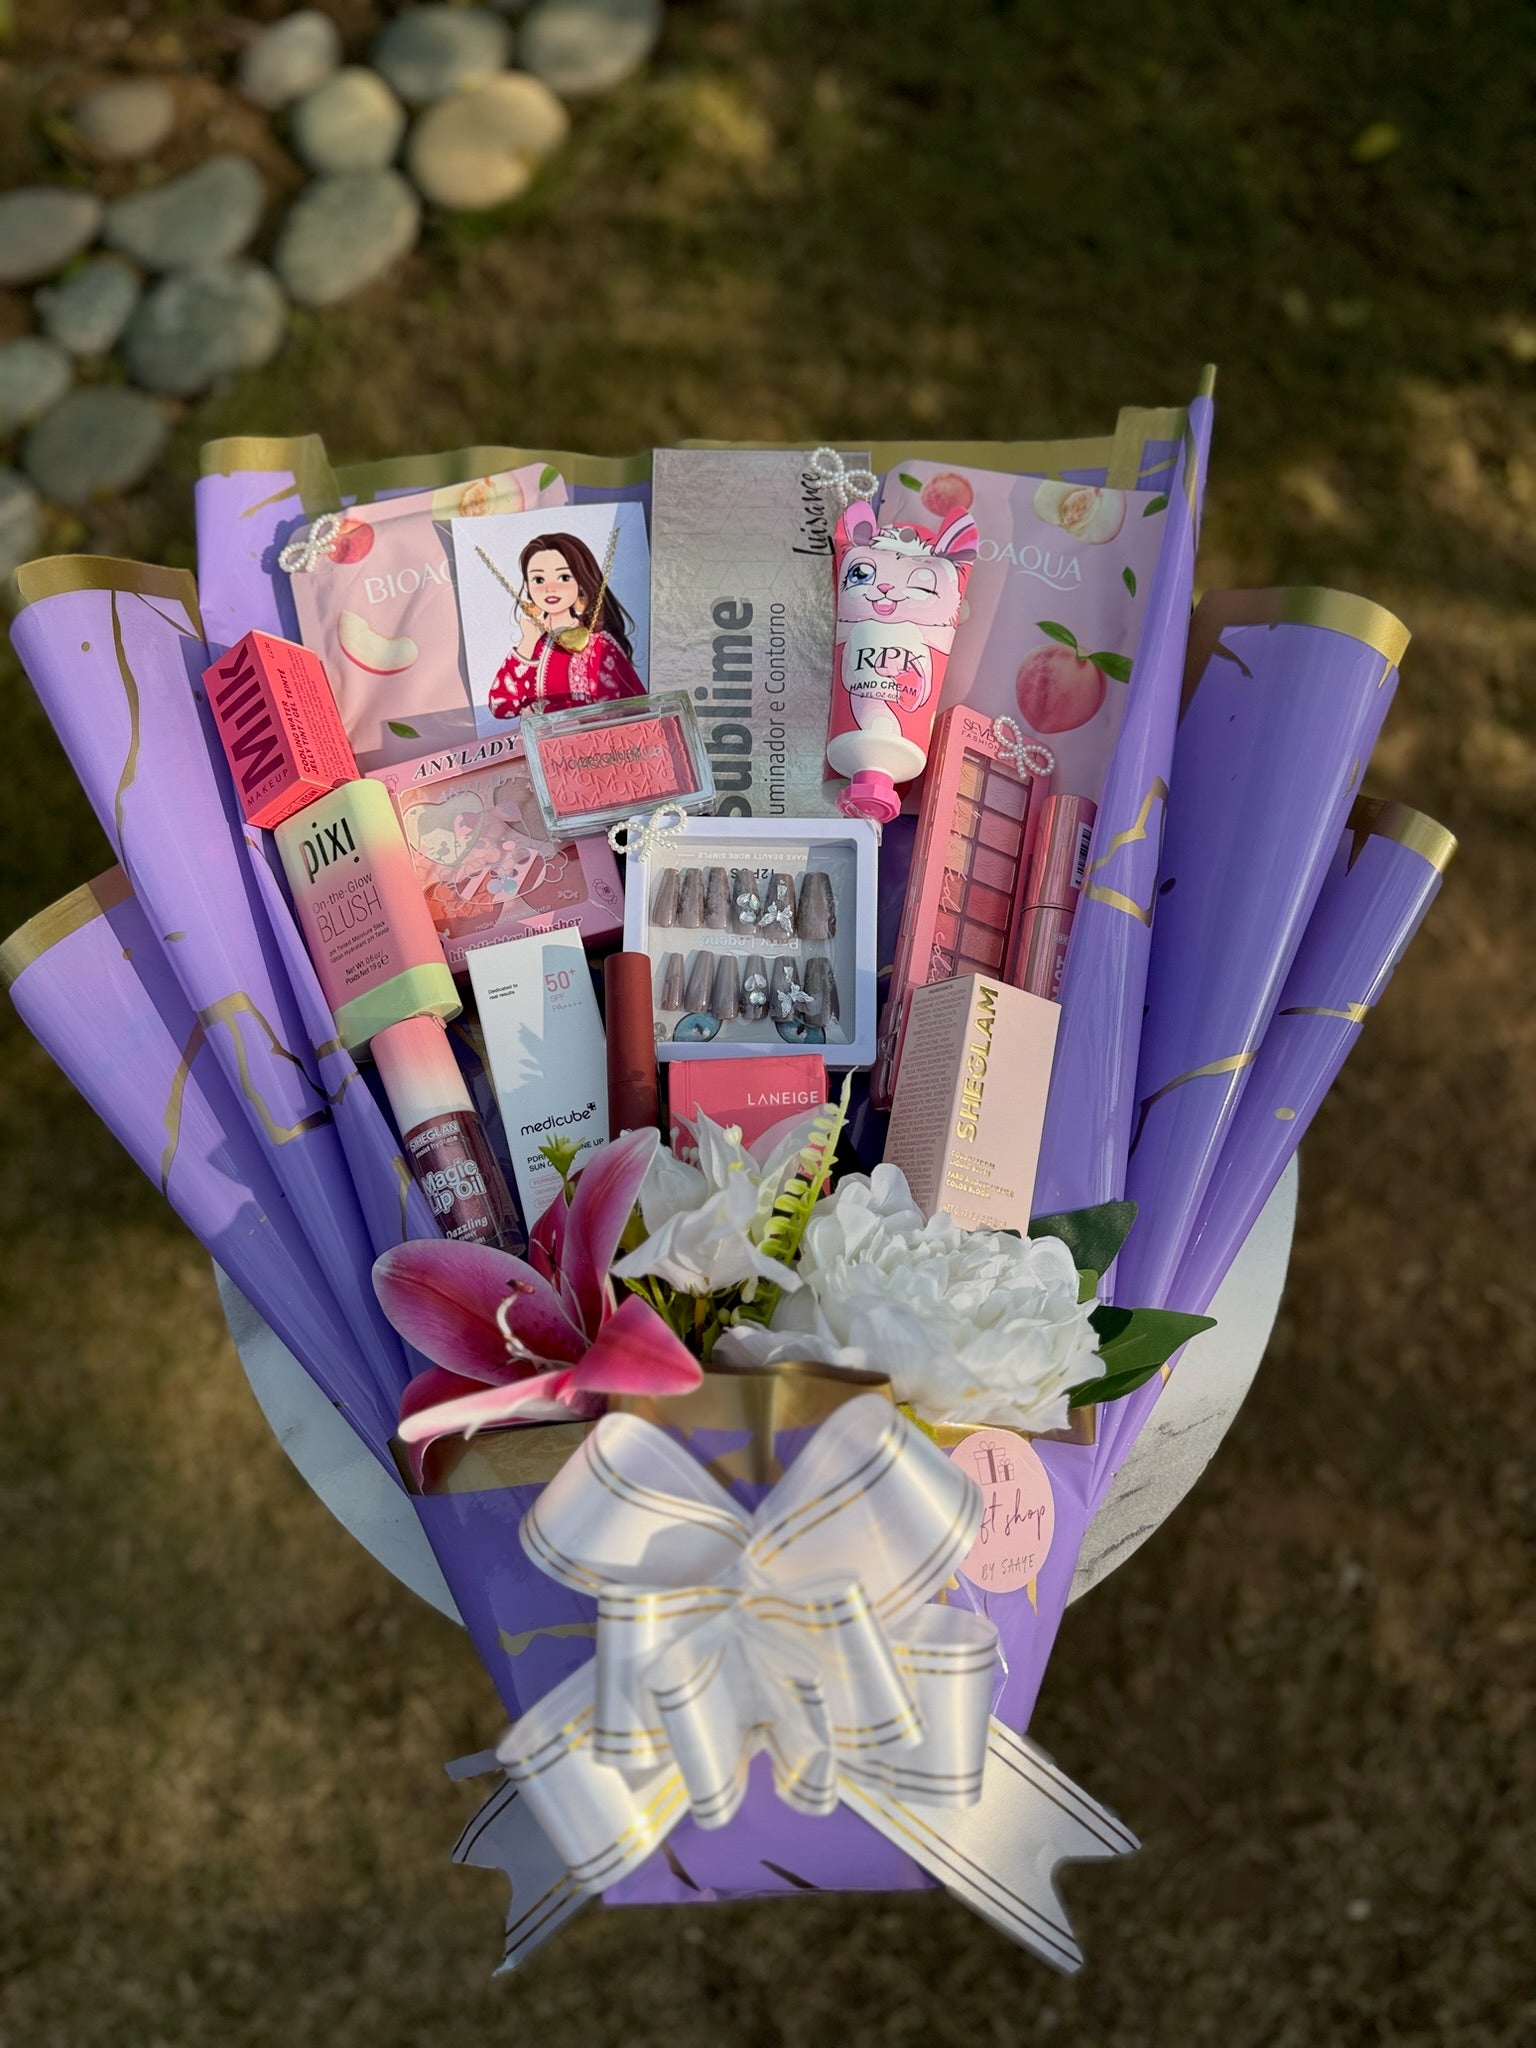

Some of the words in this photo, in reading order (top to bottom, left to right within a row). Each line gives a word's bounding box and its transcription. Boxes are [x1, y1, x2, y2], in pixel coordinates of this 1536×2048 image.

[765, 602, 785, 695] Contorno
[854, 646, 926, 678] RPK
[850, 681, 878, 692] HAND
[881, 681, 917, 697] CREAM
[282, 700, 297, 731] WATER
[290, 702, 300, 718] GEL
[771, 701, 786, 713] e
[297, 725, 309, 745] TINT
[293, 732, 311, 773] COOLING
[305, 747, 319, 775] JELLY
[413, 735, 519, 780] ANYLADY
[247, 768, 289, 807] MAKEUP
[730, 868, 774, 881] 12PS
[312, 872, 374, 915] On-the-Glow
[316, 885, 383, 944] BLUSH
[956, 983, 999, 1143] SHEGLAM
[747, 1091, 819, 1106] LANEIGE
[521, 1109, 591, 1136] medicube
[593, 1137, 604, 1146] UP
[422, 1159, 478, 1194] Magic
[529, 1162, 546, 1172] SUN
[428, 1189, 454, 1216] Lip
[455, 1173, 486, 1199] Oil
[446, 1217, 487, 1239] Dazzling
[1005, 1488, 1045, 1541] shop
